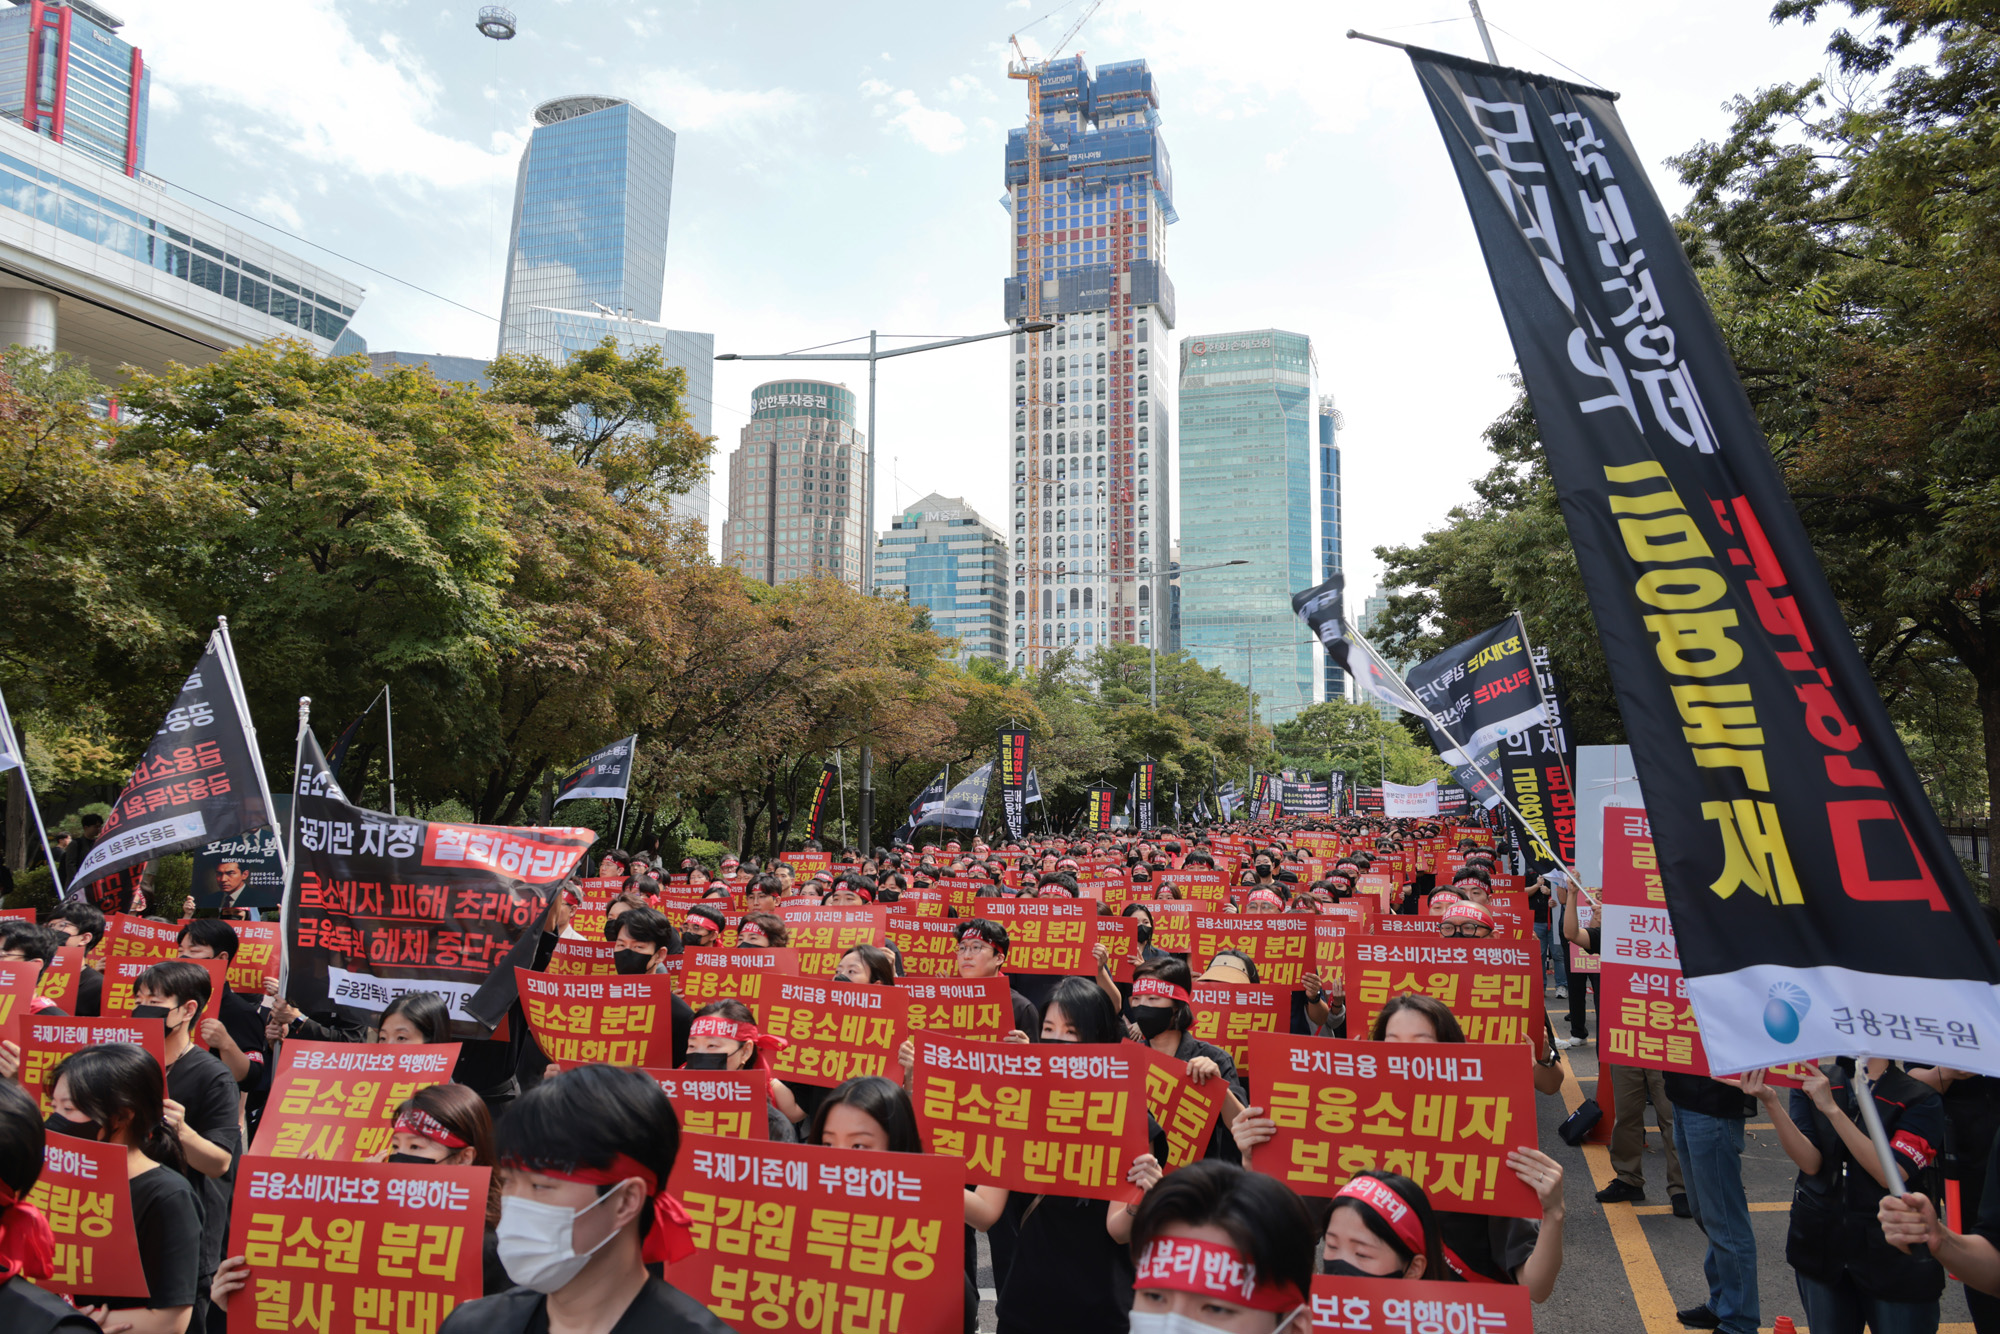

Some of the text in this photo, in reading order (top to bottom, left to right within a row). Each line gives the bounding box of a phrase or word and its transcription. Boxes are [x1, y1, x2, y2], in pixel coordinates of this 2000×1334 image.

[1043, 75, 1072, 85] HYUNDAI
[757, 394, 827, 411] 신한투자증권
[925, 509, 960, 522] iM증권
[1603, 460, 1805, 906] 금융독재
[202, 837, 278, 857] 모피아의 봄
[1295, 839, 1337, 849] 금소원 분리
[1453, 833, 1490, 842] 금융소비자
[360, 823, 578, 883] 지정 철회하라!
[1316, 849, 1334, 858] 반대!
[604, 880, 623, 888] 늘리는
[1105, 889, 1127, 902] 분리
[1191, 886, 1225, 899] 독립성
[391, 883, 449, 920] 피해
[916, 903, 943, 917] 분리
[987, 904, 1083, 916] 모피아 자리만 늘리는
[1164, 904, 1192, 912] 막아내고
[1451, 906, 1483, 921] 분리 반대
[785, 911, 874, 922] 모피아 자리만 늘리는
[890, 918, 957, 933] 관치금융 막아내고
[1196, 916, 1307, 931] 금융소비자보호 역행하는
[124, 921, 155, 939] 관치금융
[245, 926, 274, 939] 늘리는
[837, 927, 876, 949] 분리
[1046, 921, 1086, 944] 분리
[237, 944, 273, 966] 분리
[371, 927, 429, 965] 해체
[569, 945, 593, 957] 자리만
[1198, 933, 1307, 959] 금소원 분리
[1356, 944, 1530, 966] 금융소비자보호 역행하는
[695, 952, 775, 968] 관치금융 막아내고
[1257, 962, 1303, 986] 반대!
[1628, 972, 1670, 996] 실익
[335, 978, 389, 1004] 금융감독원
[527, 978, 652, 998] 모피아 자리만 늘리는
[781, 984, 883, 1009] 관치금융 막아내고
[940, 985, 986, 998] 막아내고
[1140, 978, 1175, 998] 분리 반대
[1192, 988, 1274, 1005] 자리만 늘리는
[1359, 970, 1531, 1009] 금소원 분리
[528, 999, 593, 1034] 금소원
[600, 1005, 656, 1035] 분리
[698, 1019, 739, 1038] 분리 반대
[767, 1005, 896, 1049] 금융소비자
[1226, 1011, 1278, 1040] 분리
[1831, 1006, 1981, 1050] 금융감독원
[33, 1025, 144, 1046] 국제기준에 부합하는
[1462, 1016, 1529, 1044] 반대!
[538, 1032, 648, 1066] 반대한다!
[1608, 1027, 1693, 1066] 피눈물
[293, 1050, 448, 1074] 금융소비자보호 역행하는
[772, 1042, 888, 1082] 보호하자!
[923, 1043, 1129, 1080] 금융소비자보호 역행하는
[1289, 1048, 1483, 1082] 관치금융 막아내고
[278, 1078, 381, 1119] 금소원
[682, 1080, 752, 1101] 역행하는
[923, 1076, 1129, 1137] 금소원 분리
[1269, 1082, 1512, 1145] 금융소비자
[683, 1109, 752, 1140] 분리
[271, 1121, 345, 1160] 결사
[931, 1128, 1121, 1187] 결사 반대!
[693, 1149, 923, 1202] 국제기준에 부합하는
[1287, 1139, 1500, 1201] 보호하자!
[250, 1171, 471, 1211] 금융소비자보호 역행하는
[1373, 1187, 1408, 1224] 반대
[245, 1213, 466, 1282] 금소원 분리
[682, 1190, 942, 1281] 금감원 독립성
[1151, 1240, 1256, 1300] 분리 반대
[254, 1278, 456, 1334] 결사 반대!
[708, 1264, 905, 1334] 보장하라!
[1382, 1298, 1507, 1334] 역행하는
